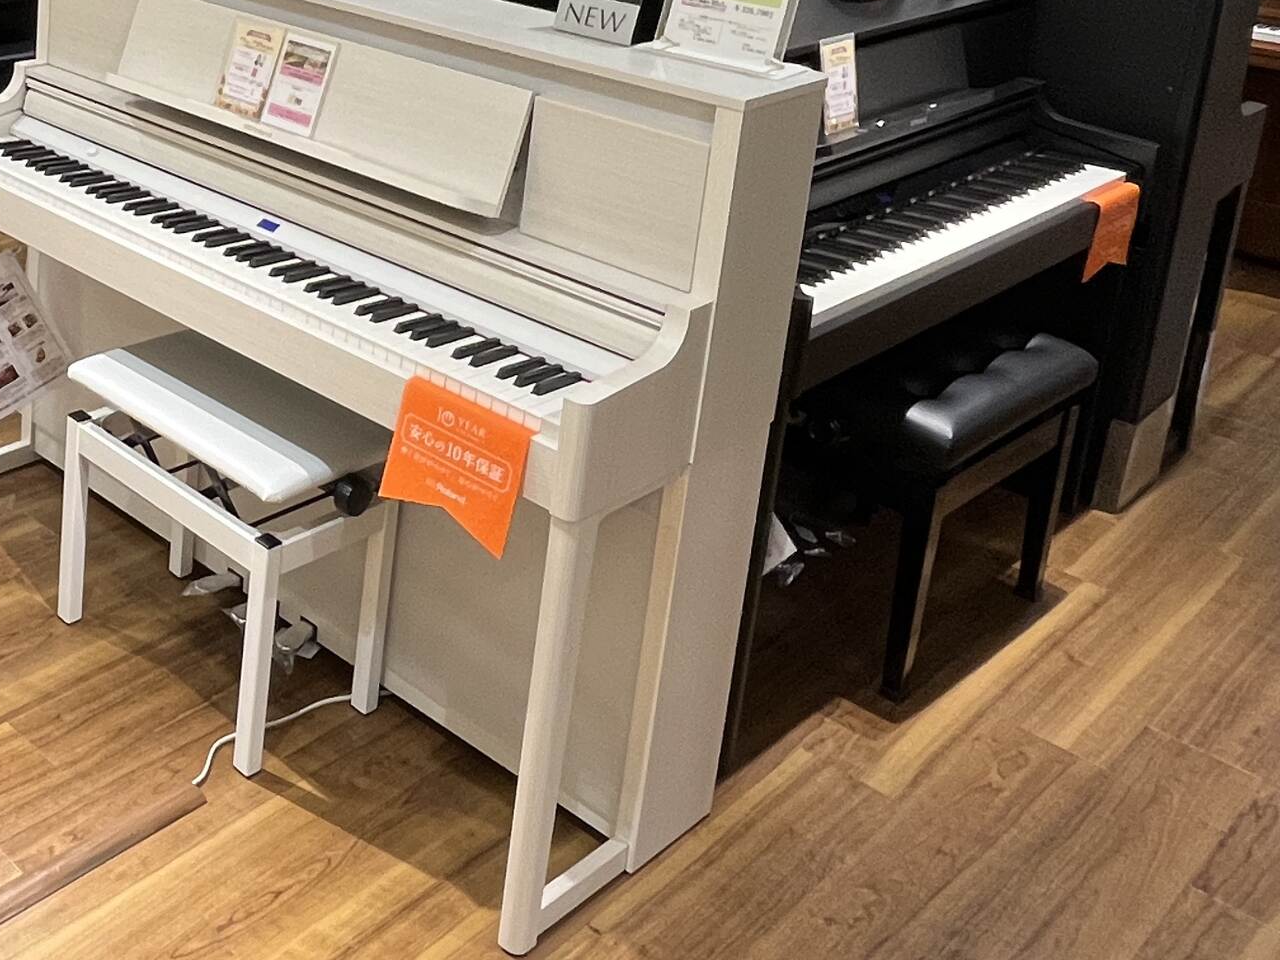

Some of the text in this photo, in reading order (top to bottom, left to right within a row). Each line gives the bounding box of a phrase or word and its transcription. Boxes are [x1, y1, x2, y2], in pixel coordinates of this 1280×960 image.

[564, 2, 628, 33] NEW
[457, 416, 488, 438] YEAR
[408, 423, 506, 484] 安心の10年保証
